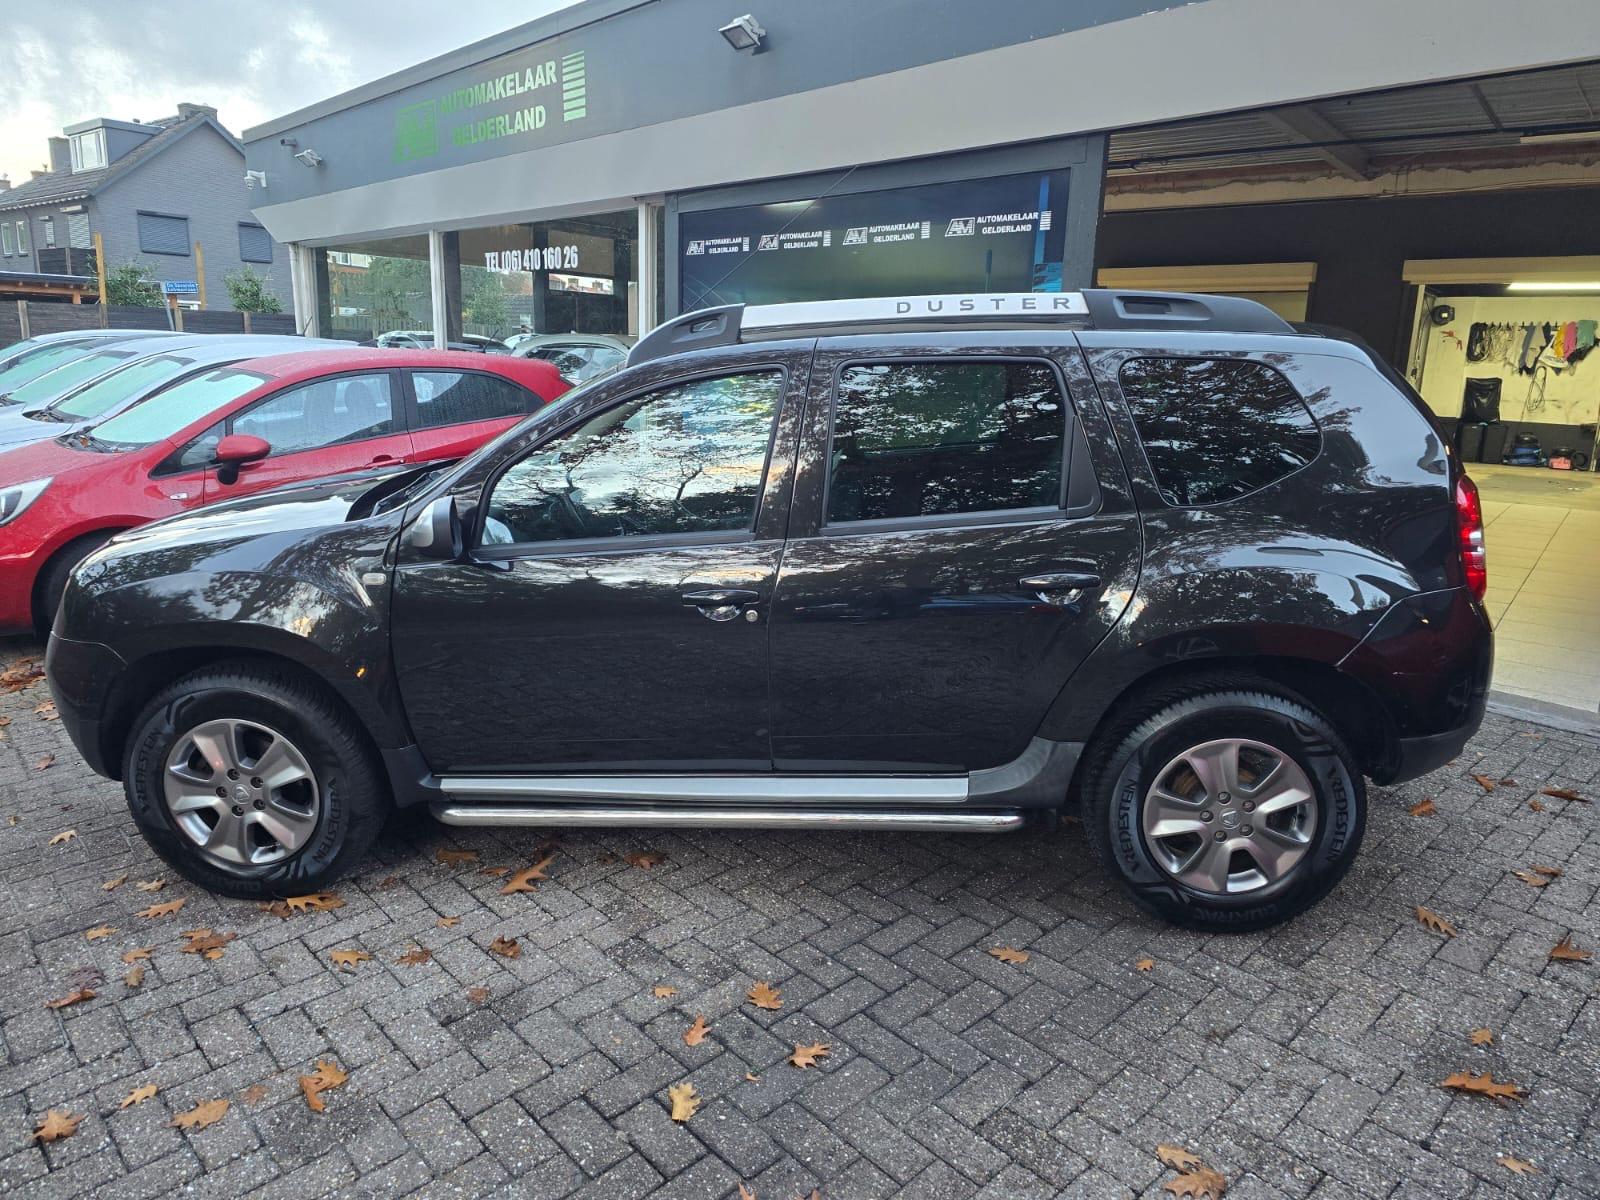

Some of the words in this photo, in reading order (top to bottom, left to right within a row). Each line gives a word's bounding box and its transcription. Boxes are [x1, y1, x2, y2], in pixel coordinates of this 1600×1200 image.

[440, 60, 557, 113] AUTOMAKELAAR
[452, 105, 546, 147] GELDERLAND
[977, 211, 1039, 224] AUTOMAKELAAR
[869, 222, 920, 233] AUTOMAKELAAR
[982, 224, 1032, 235] GELDERLAND
[705, 237, 742, 246] AUTOMAKELAAR
[779, 231, 823, 241] AUTOMAKELAAR
[873, 233, 915, 243] GELDERLAND
[708, 246, 739, 254] GELDERLAND
[783, 241, 819, 249] GELDERLAND
[485, 252, 499, 272] TEL
[502, 250, 521, 273] (06)
[523, 248, 541, 270] 410
[543, 246, 562, 269] 160
[564, 245, 578, 268] 26
[896, 297, 1072, 314] DUSTER
[1118, 779, 1138, 874] VREDESTEIN
